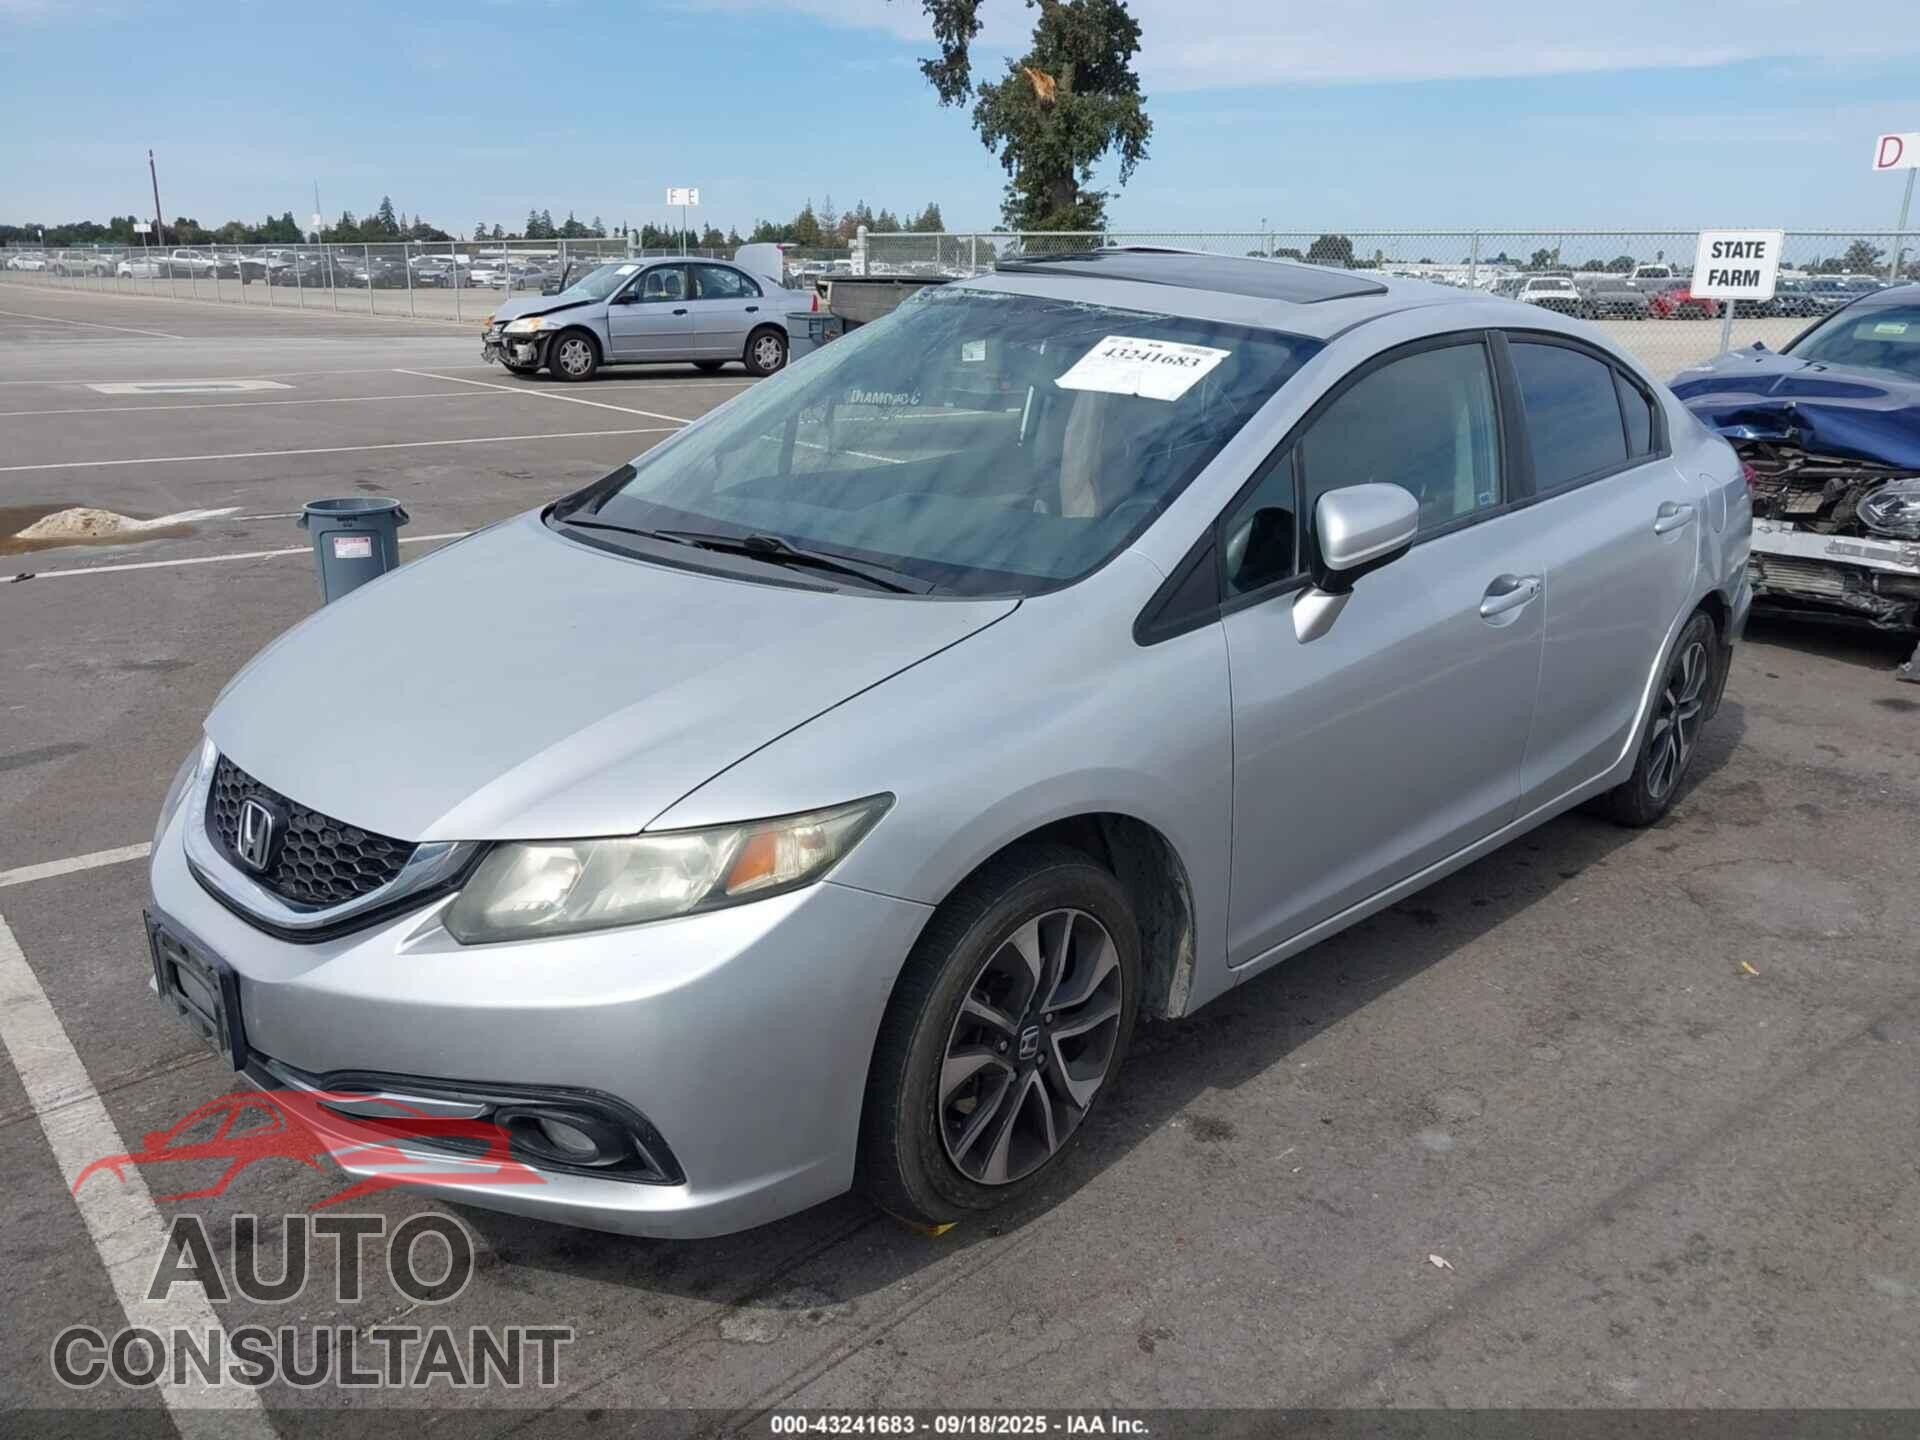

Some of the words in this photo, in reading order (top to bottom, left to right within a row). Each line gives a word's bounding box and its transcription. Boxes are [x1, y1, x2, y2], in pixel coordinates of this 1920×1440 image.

[1878, 136, 1903, 168] D
[1711, 241, 1766, 259] STATE
[1707, 269, 1761, 287] FARM
[1102, 348, 1201, 367] 43241683
